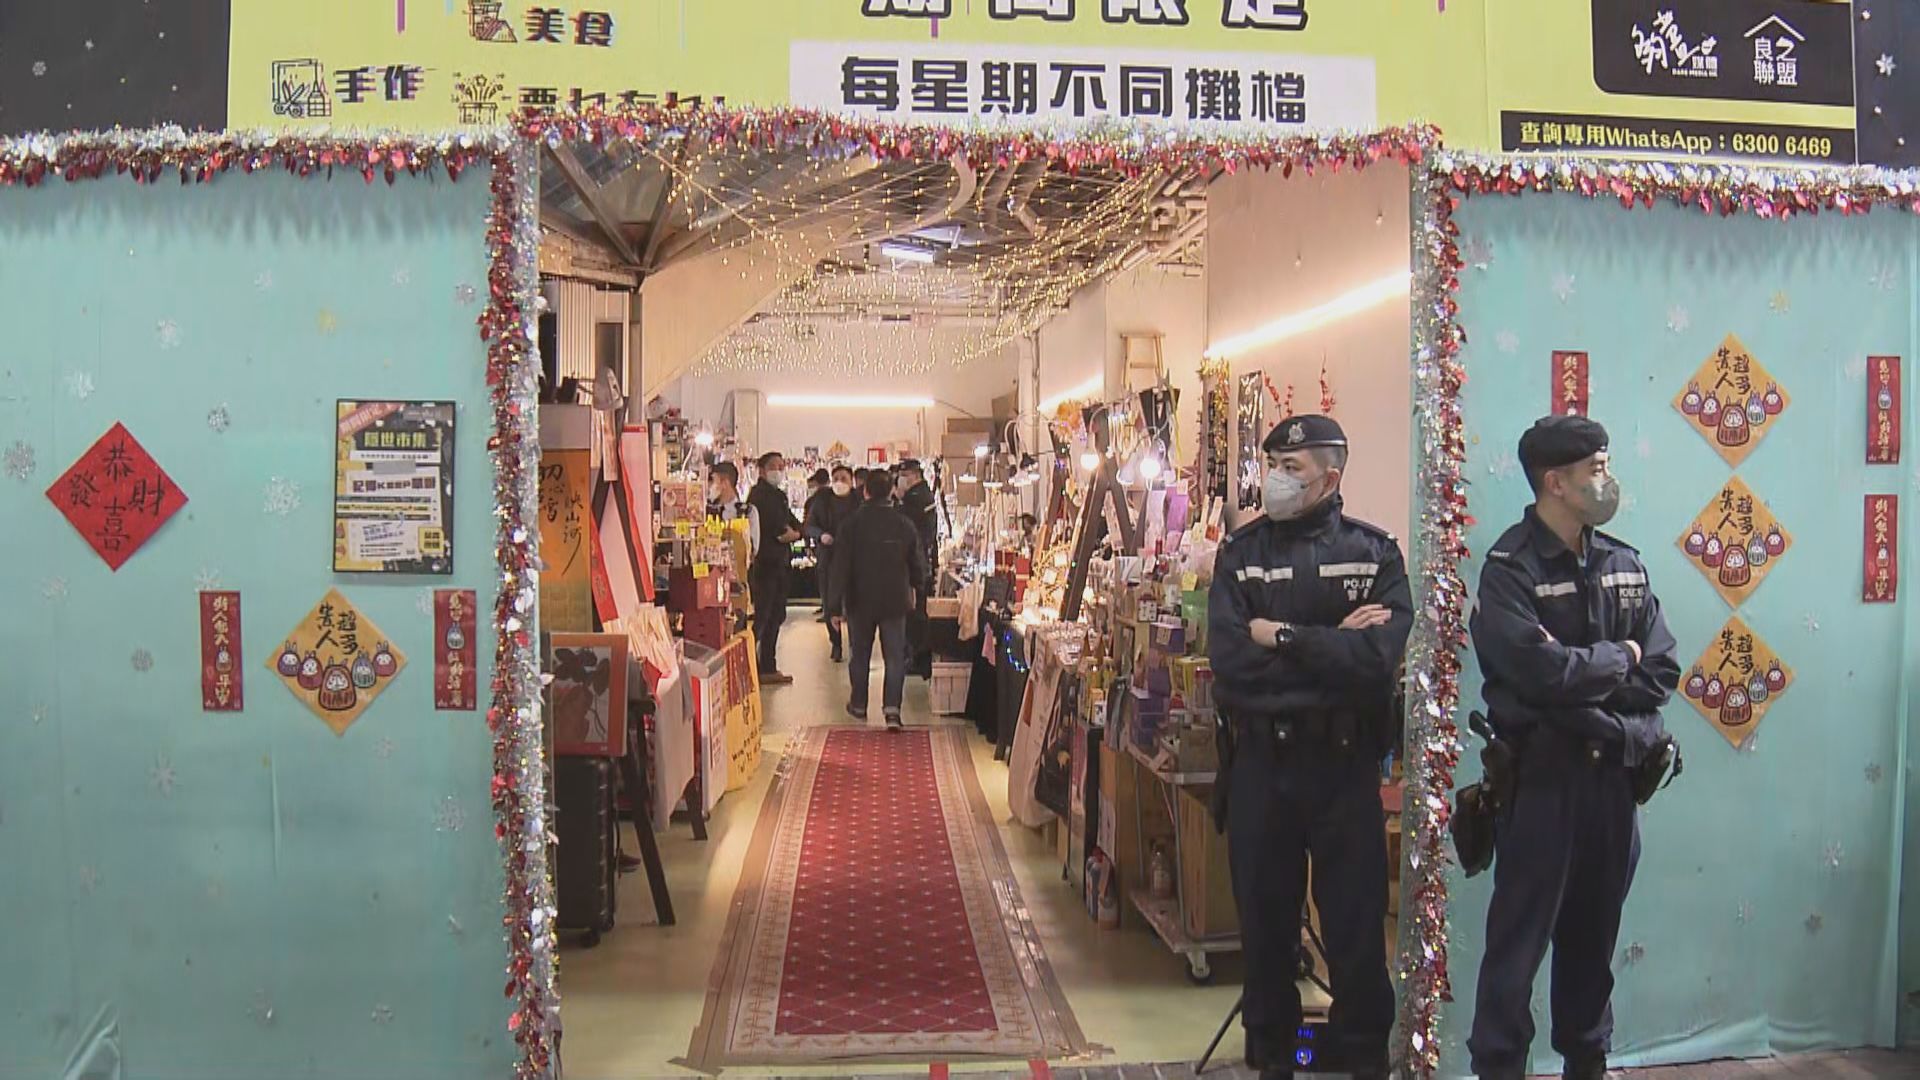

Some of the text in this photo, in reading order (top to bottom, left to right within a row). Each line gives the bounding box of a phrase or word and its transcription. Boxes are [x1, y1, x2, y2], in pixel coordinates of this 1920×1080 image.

[525, 8, 615, 46] 美食
[334, 64, 427, 104] 手作
[841, 56, 1306, 122] 每星期不同攤檔
[1753, 60, 1798, 86] 聯盟
[1732, 132, 1779, 154] 6300
[1785, 135, 1832, 157] 6469
